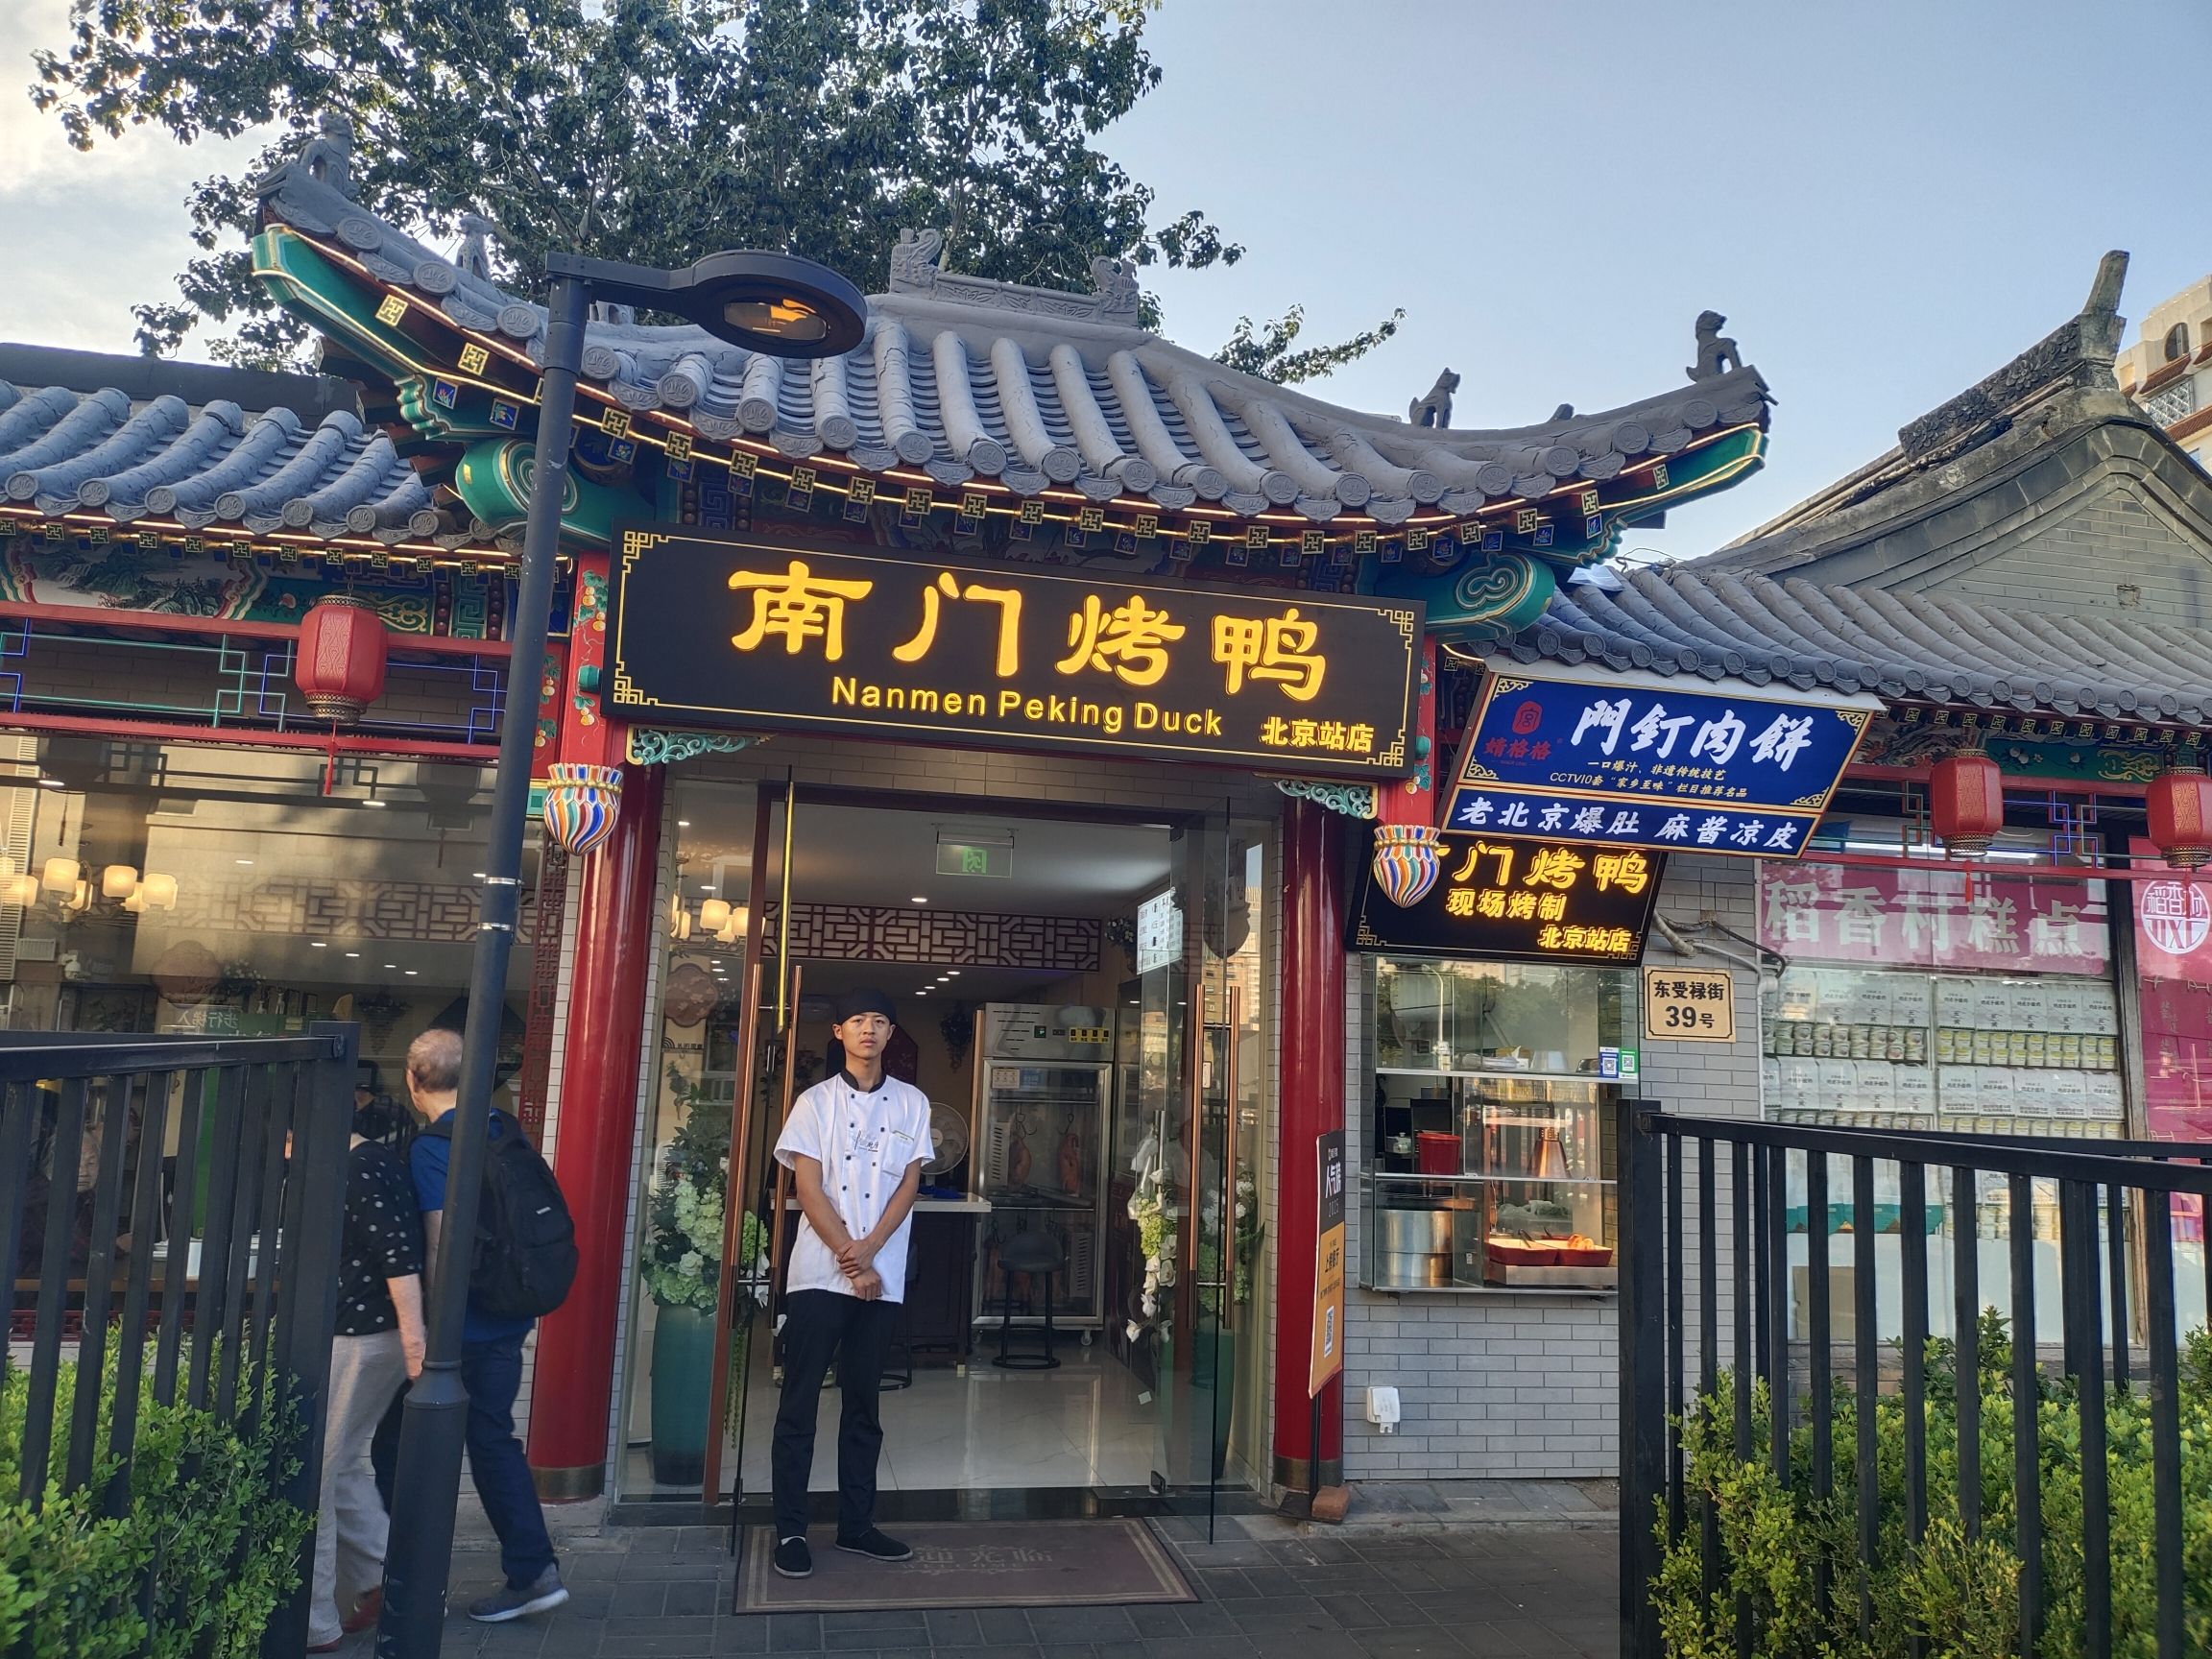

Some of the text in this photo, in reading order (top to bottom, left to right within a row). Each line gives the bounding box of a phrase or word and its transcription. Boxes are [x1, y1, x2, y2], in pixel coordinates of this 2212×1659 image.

[728, 561, 1328, 702] 南门烤鸭
[831, 677, 1223, 735] Nanmen Peking Duck
[1261, 716, 1375, 754] 北京站店
[1457, 796, 1798, 850] 老北京爆肚 麻酱凉皮
[1438, 840, 1648, 894] 门烤鸭
[1447, 888, 1567, 921] 现场烤制
[1765, 879, 2085, 957] 稻香村糕点
[1538, 925, 1632, 953] 北京站店
[1653, 979, 1724, 1000] 东受禄街
[1665, 1005, 1716, 1029] 39号
